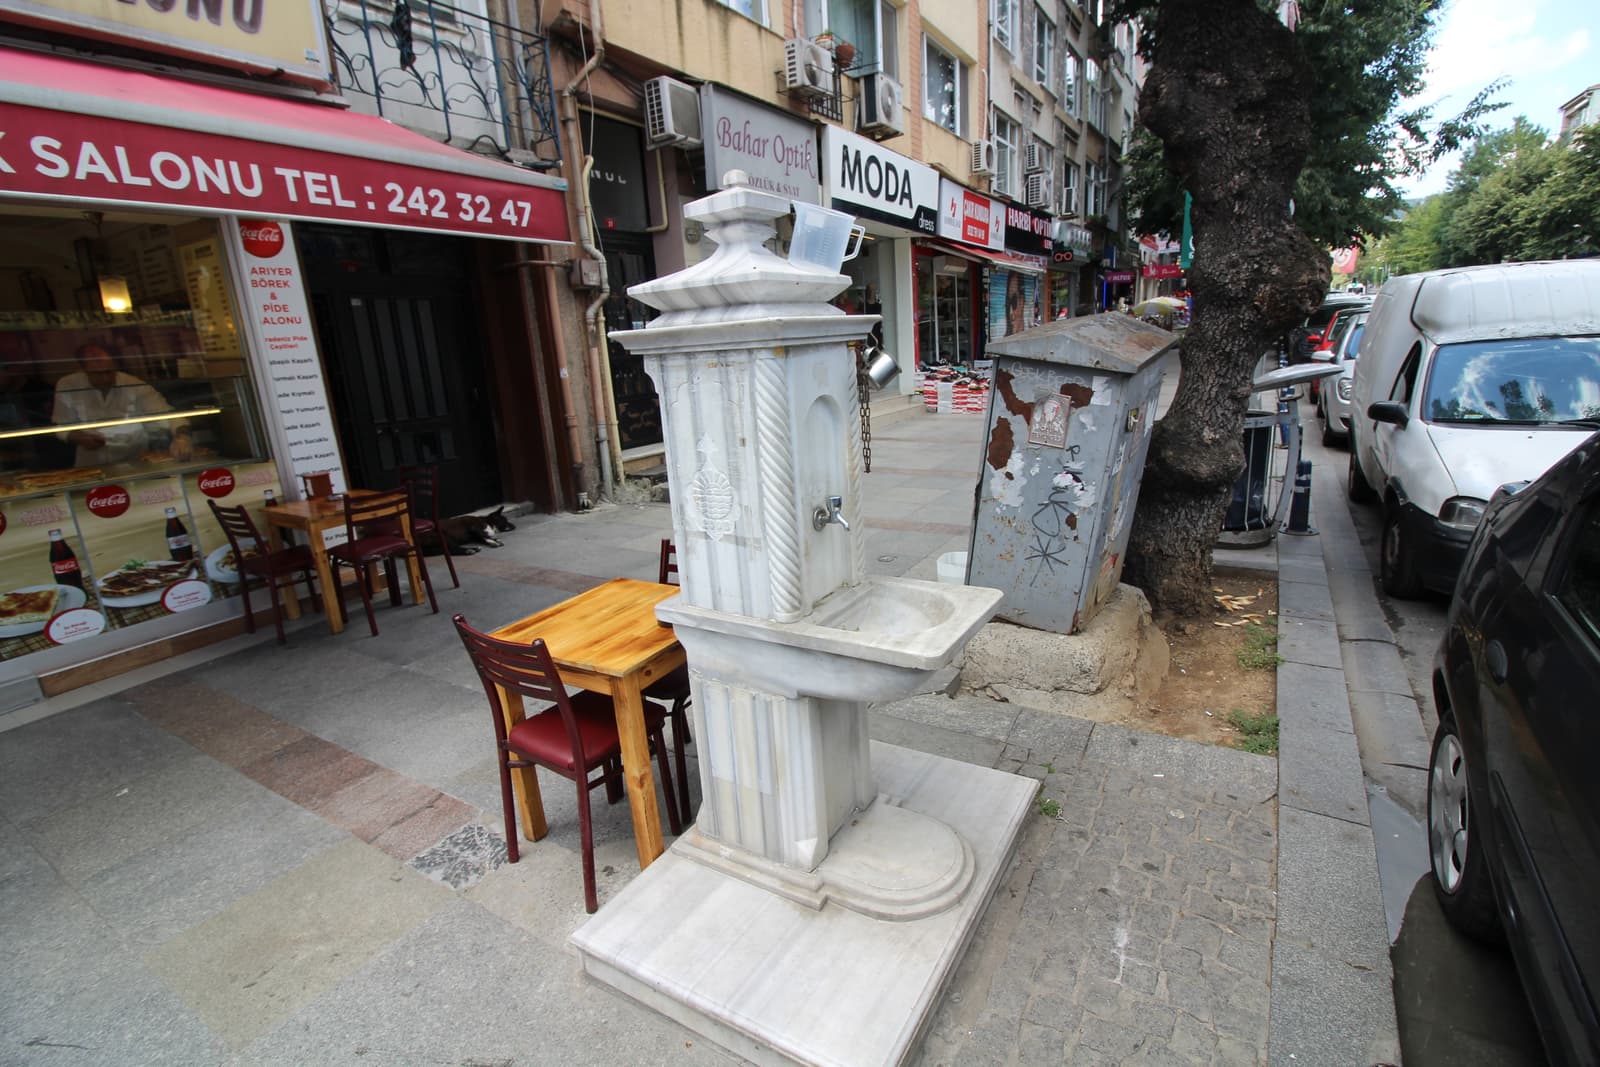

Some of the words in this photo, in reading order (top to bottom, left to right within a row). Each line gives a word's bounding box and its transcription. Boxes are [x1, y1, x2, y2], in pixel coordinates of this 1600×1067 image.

[716, 116, 770, 159] Bahar
[773, 135, 817, 179] Optik
[30, 135, 264, 198] SALONU
[274, 167, 356, 208] TEL
[384, 182, 449, 219] 242
[456, 192, 493, 224] 32
[501, 199, 532, 228] 47
[748, 175, 775, 192] ÖZLÜK
[776, 183, 782, 193] &
[840, 144, 914, 209] MODA
[918, 211, 935, 232] dress
[1008, 207, 1031, 232] HARBİ
[250, 267, 293, 276] ARIYER
[251, 278, 290, 288] BÖREK
[270, 292, 278, 300] &
[263, 304, 289, 313] PİDE
[263, 317, 302, 325] ALONU
[199, 475, 232, 490] Coca-Cola
[89, 493, 127, 509] Coca-Cola
